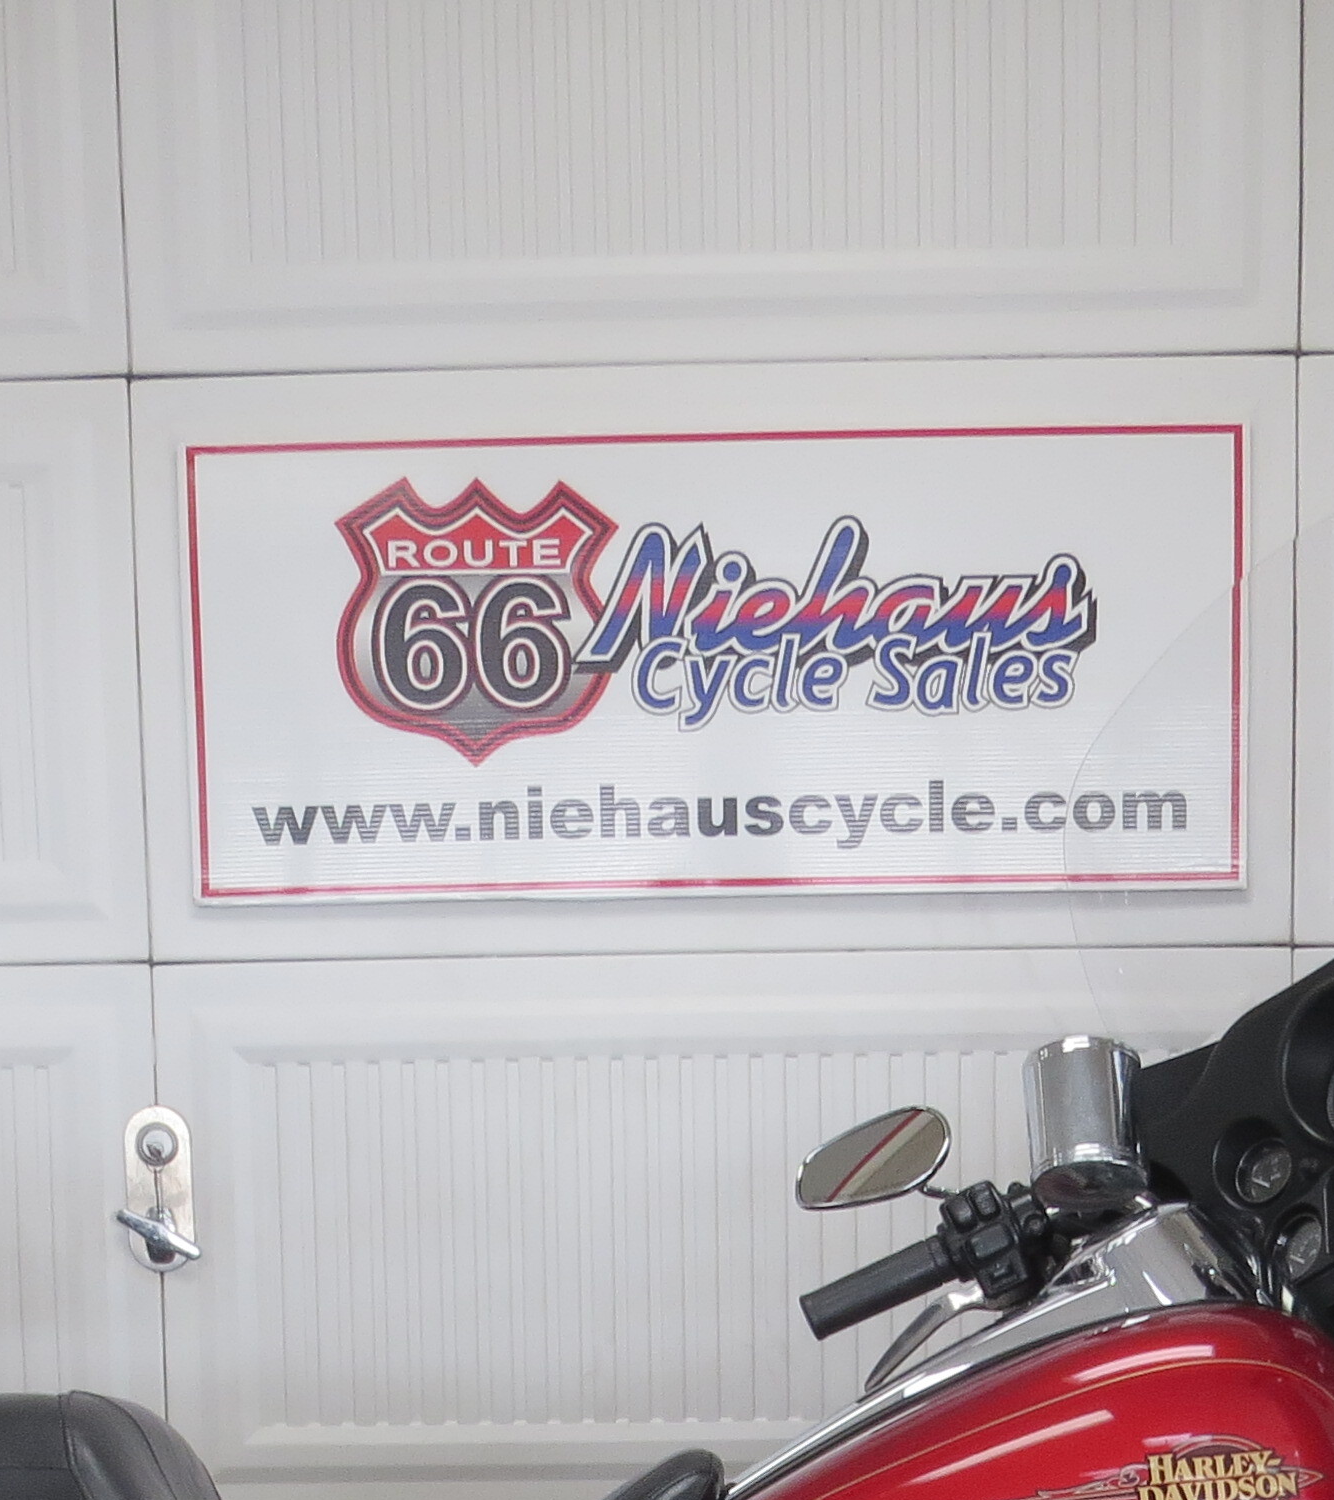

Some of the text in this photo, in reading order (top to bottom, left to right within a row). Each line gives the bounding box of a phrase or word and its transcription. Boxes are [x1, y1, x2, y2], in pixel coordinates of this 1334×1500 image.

[386, 537, 563, 569] ROUTE
[575, 515, 1095, 668] Niehaus
[375, 576, 570, 712] 66
[632, 632, 1081, 732] Cycle Sales
[251, 779, 1189, 850] www.niehauscycle.com
